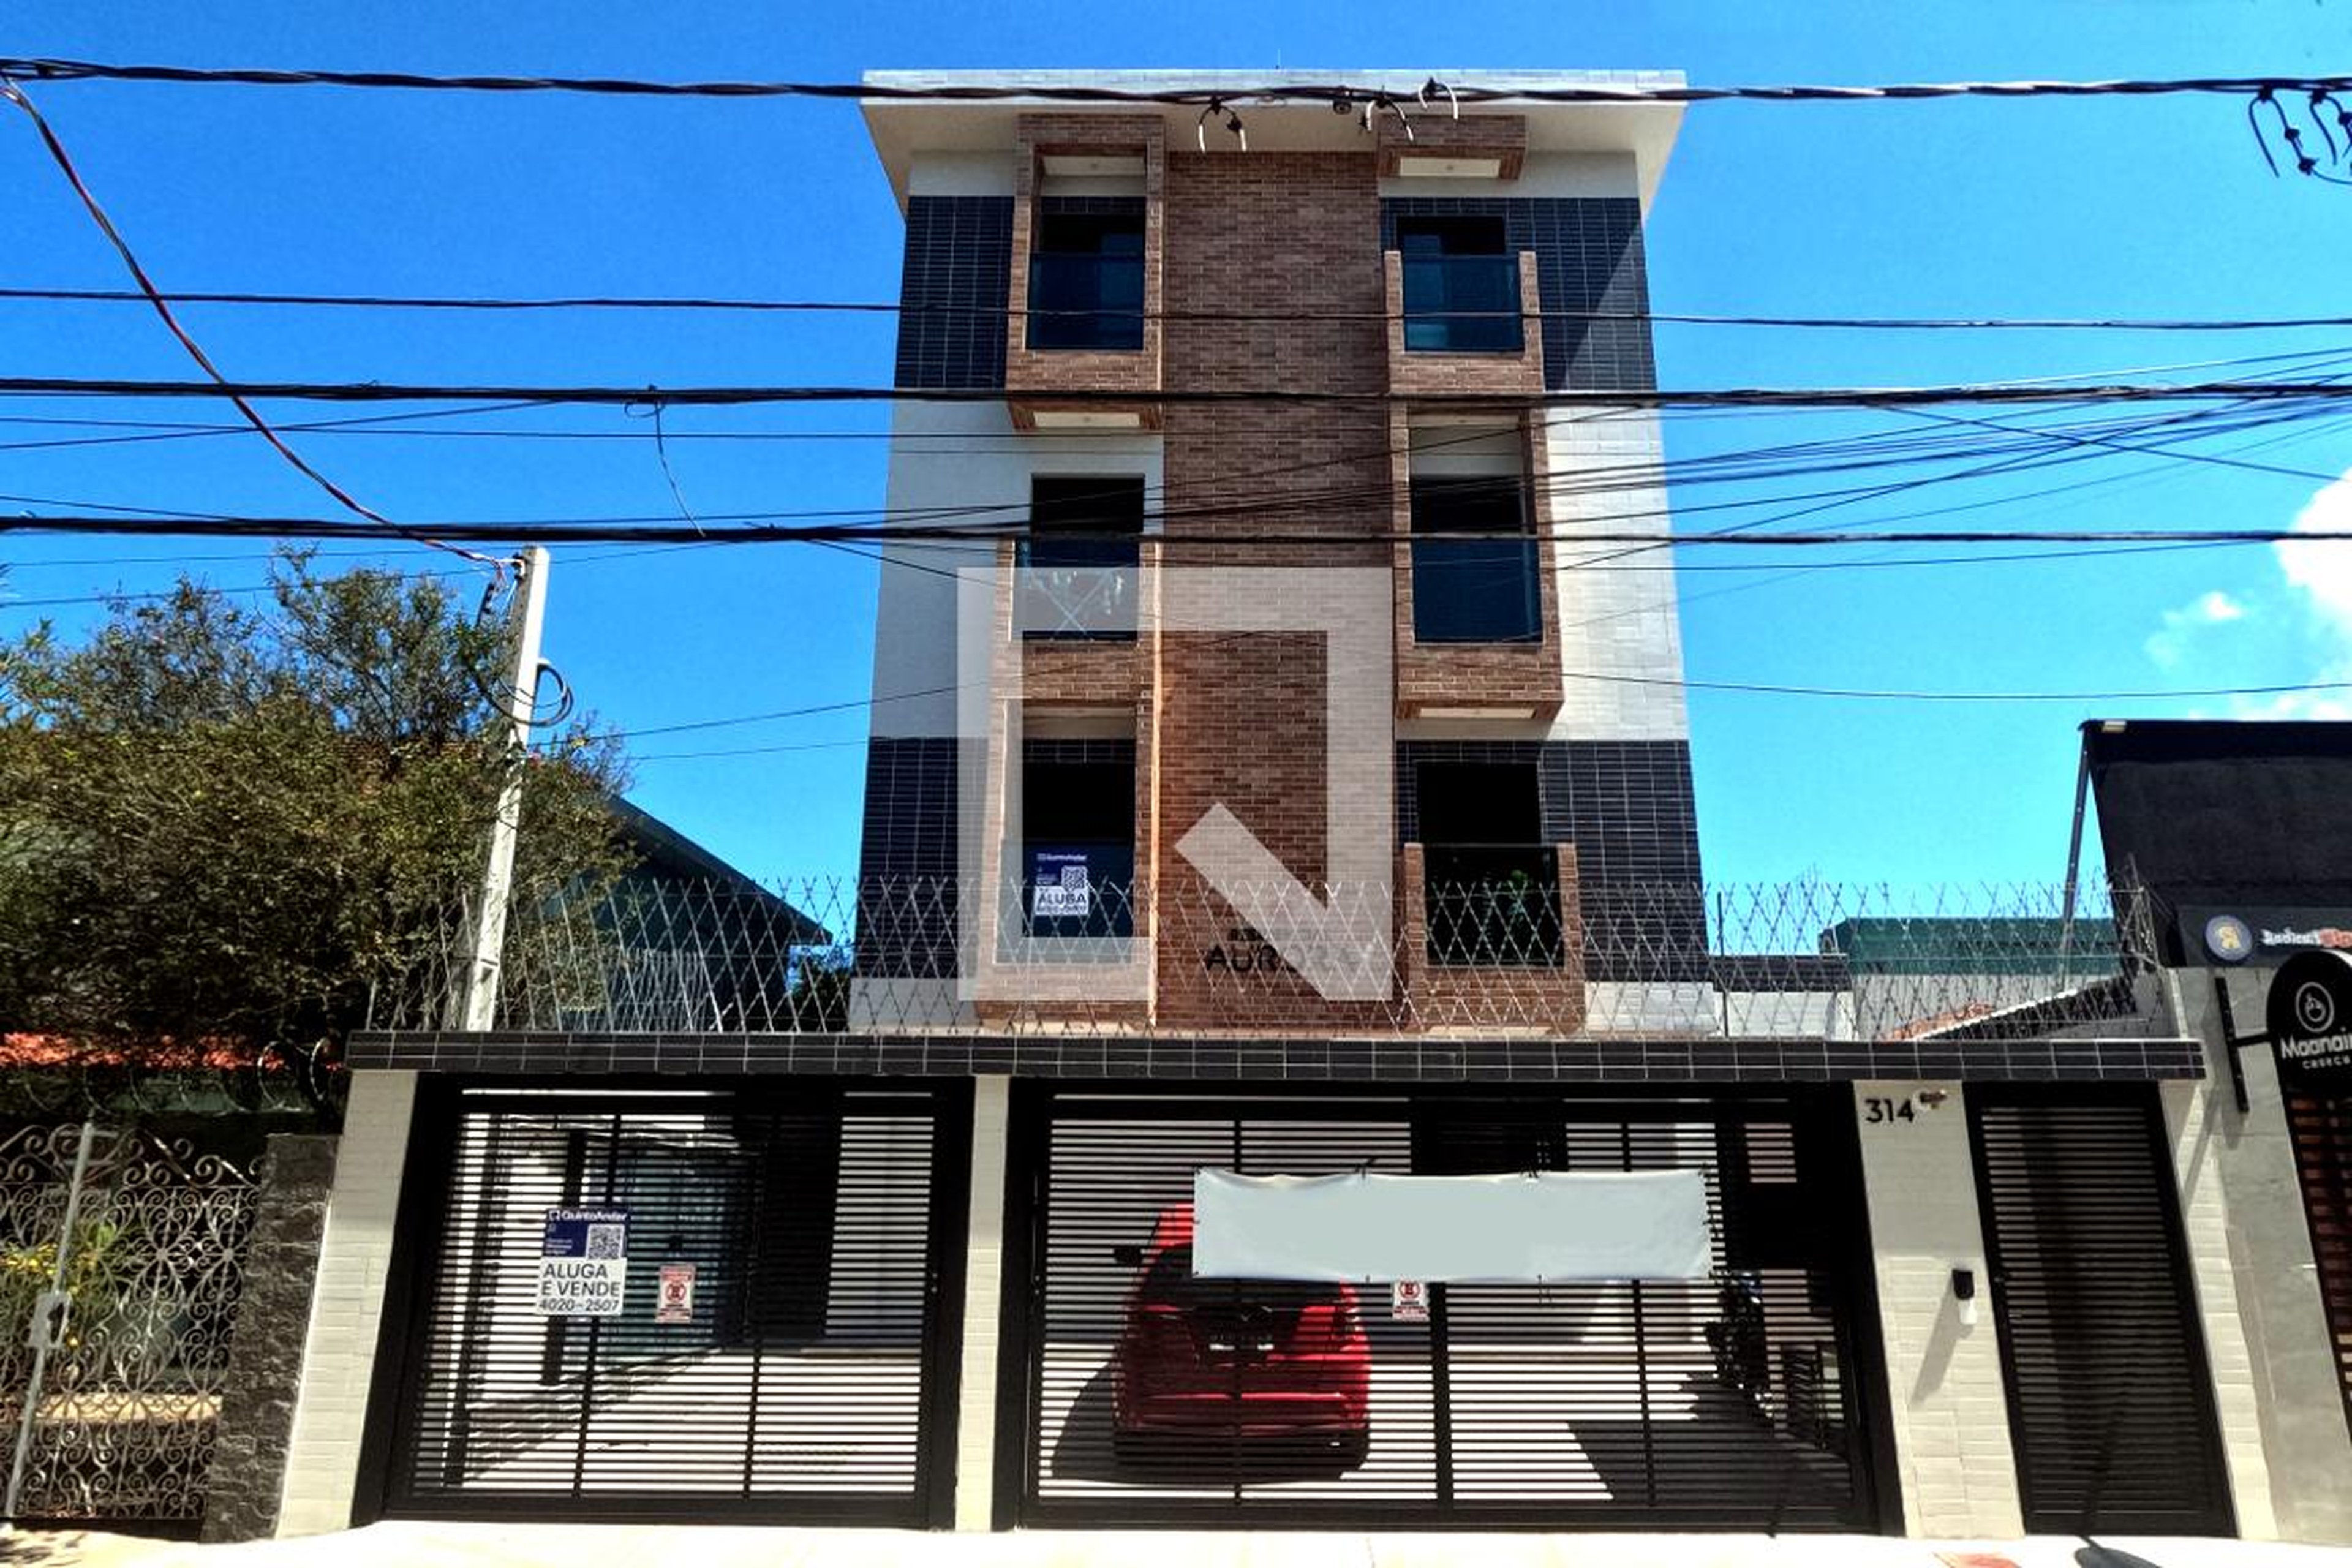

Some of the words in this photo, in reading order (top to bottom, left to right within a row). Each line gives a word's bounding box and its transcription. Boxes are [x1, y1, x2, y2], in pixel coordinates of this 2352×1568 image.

[1865, 1099, 1915, 1123] 314
[543, 1264, 608, 1279] ALUGA
[541, 1281, 553, 1295] E
[557, 1281, 621, 1297] VENDE
[538, 1298, 619, 1311] 4020-2507
